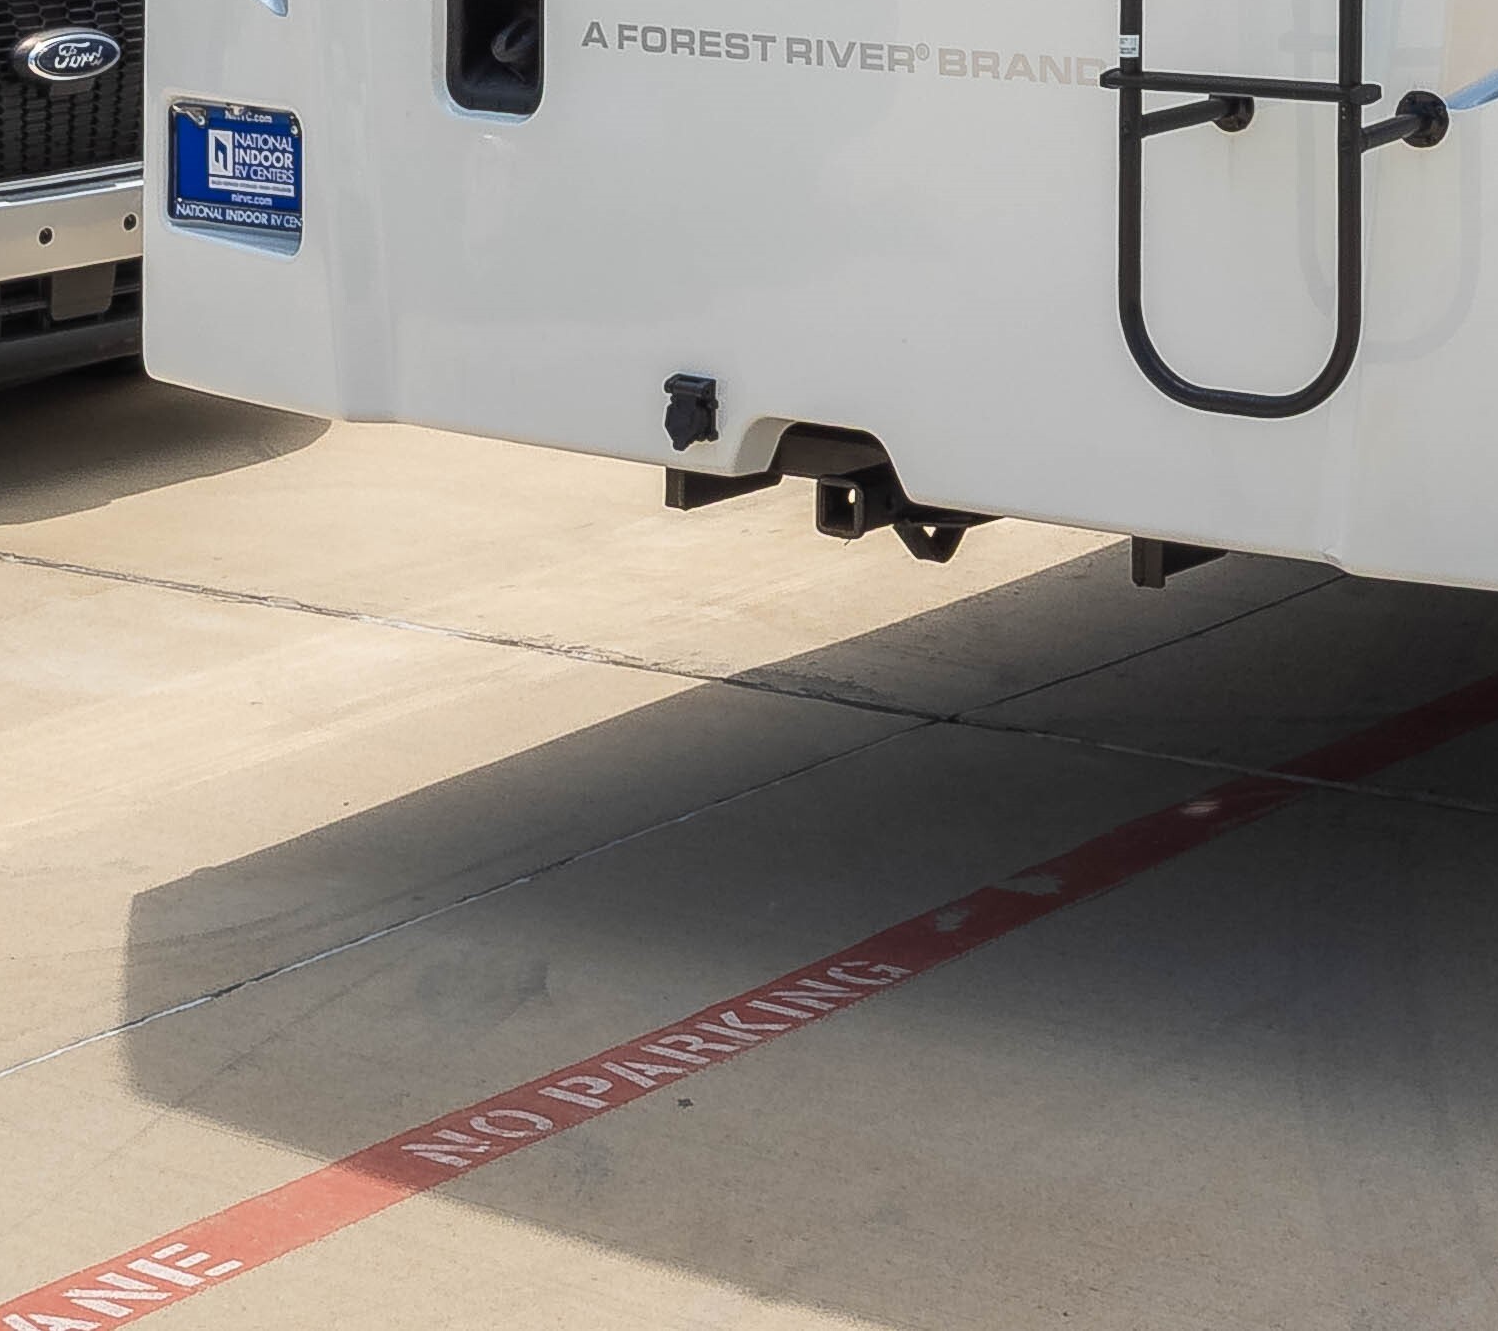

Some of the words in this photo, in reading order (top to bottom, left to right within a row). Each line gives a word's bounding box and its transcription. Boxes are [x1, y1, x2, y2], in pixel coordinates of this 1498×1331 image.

[54, 41, 104, 69] Ford
[580, 21, 609, 50] A
[617, 24, 776, 63] FOREST
[938, 48, 1103, 88] BRAND
[234, 131, 294, 153] NATIONAL
[235, 148, 294, 169] INDOOR
[235, 164, 248, 178] RV
[250, 166, 295, 183] CENTERS
[231, 192, 273, 206] nirvc.com
[176, 203, 222, 219] NATIONAL
[225, 207, 268, 225] INDOOR
[270, 213, 283, 226] RV
[400, 1108, 554, 1169] NO
[538, 960, 911, 1110] PARKING
[2, 1242, 244, 1331] ANE
